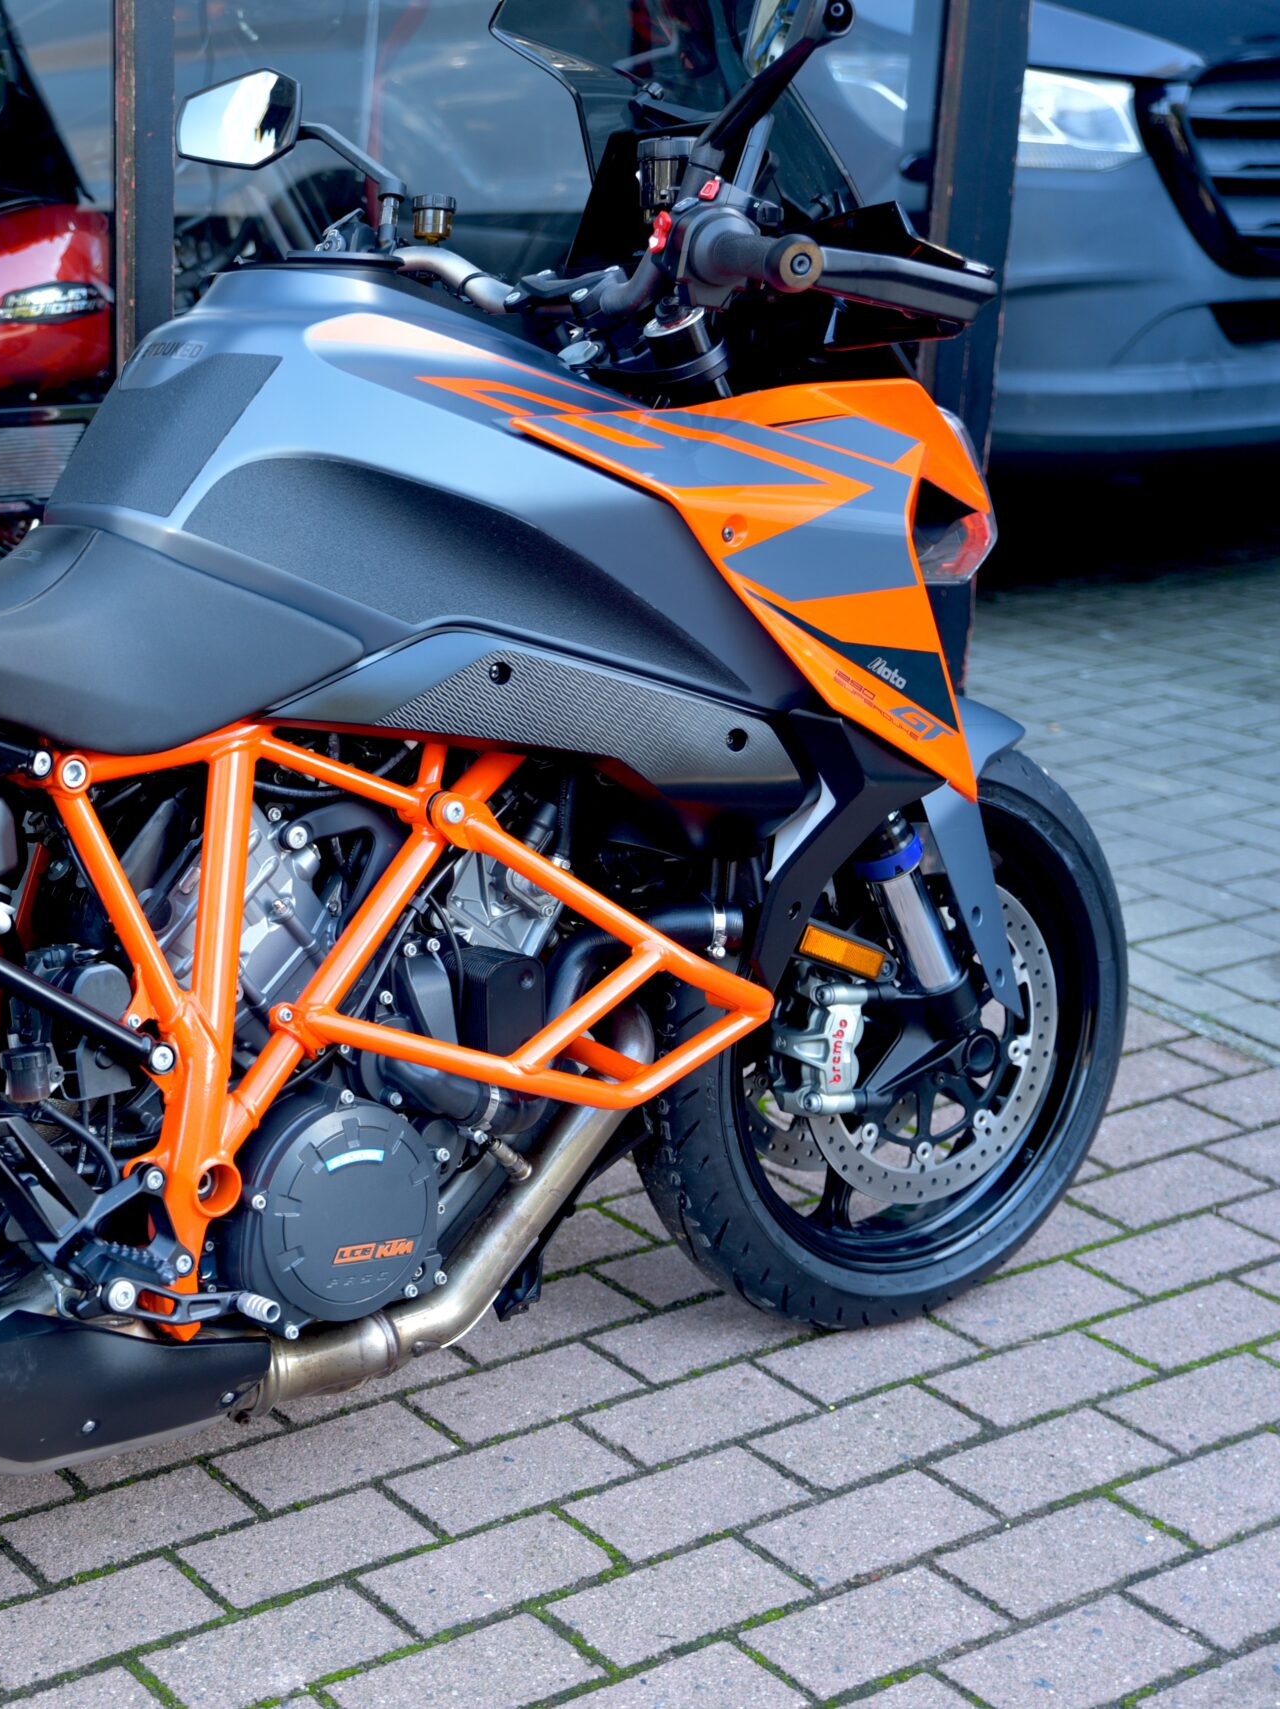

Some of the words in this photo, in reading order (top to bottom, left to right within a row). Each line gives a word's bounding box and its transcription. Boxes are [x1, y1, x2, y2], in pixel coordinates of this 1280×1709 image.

[835, 668, 876, 701] 1290
[867, 657, 907, 690] Moto
[888, 705, 956, 740] GT
[828, 1019, 848, 1085] brembo
[375, 1238, 415, 1260] KTM
